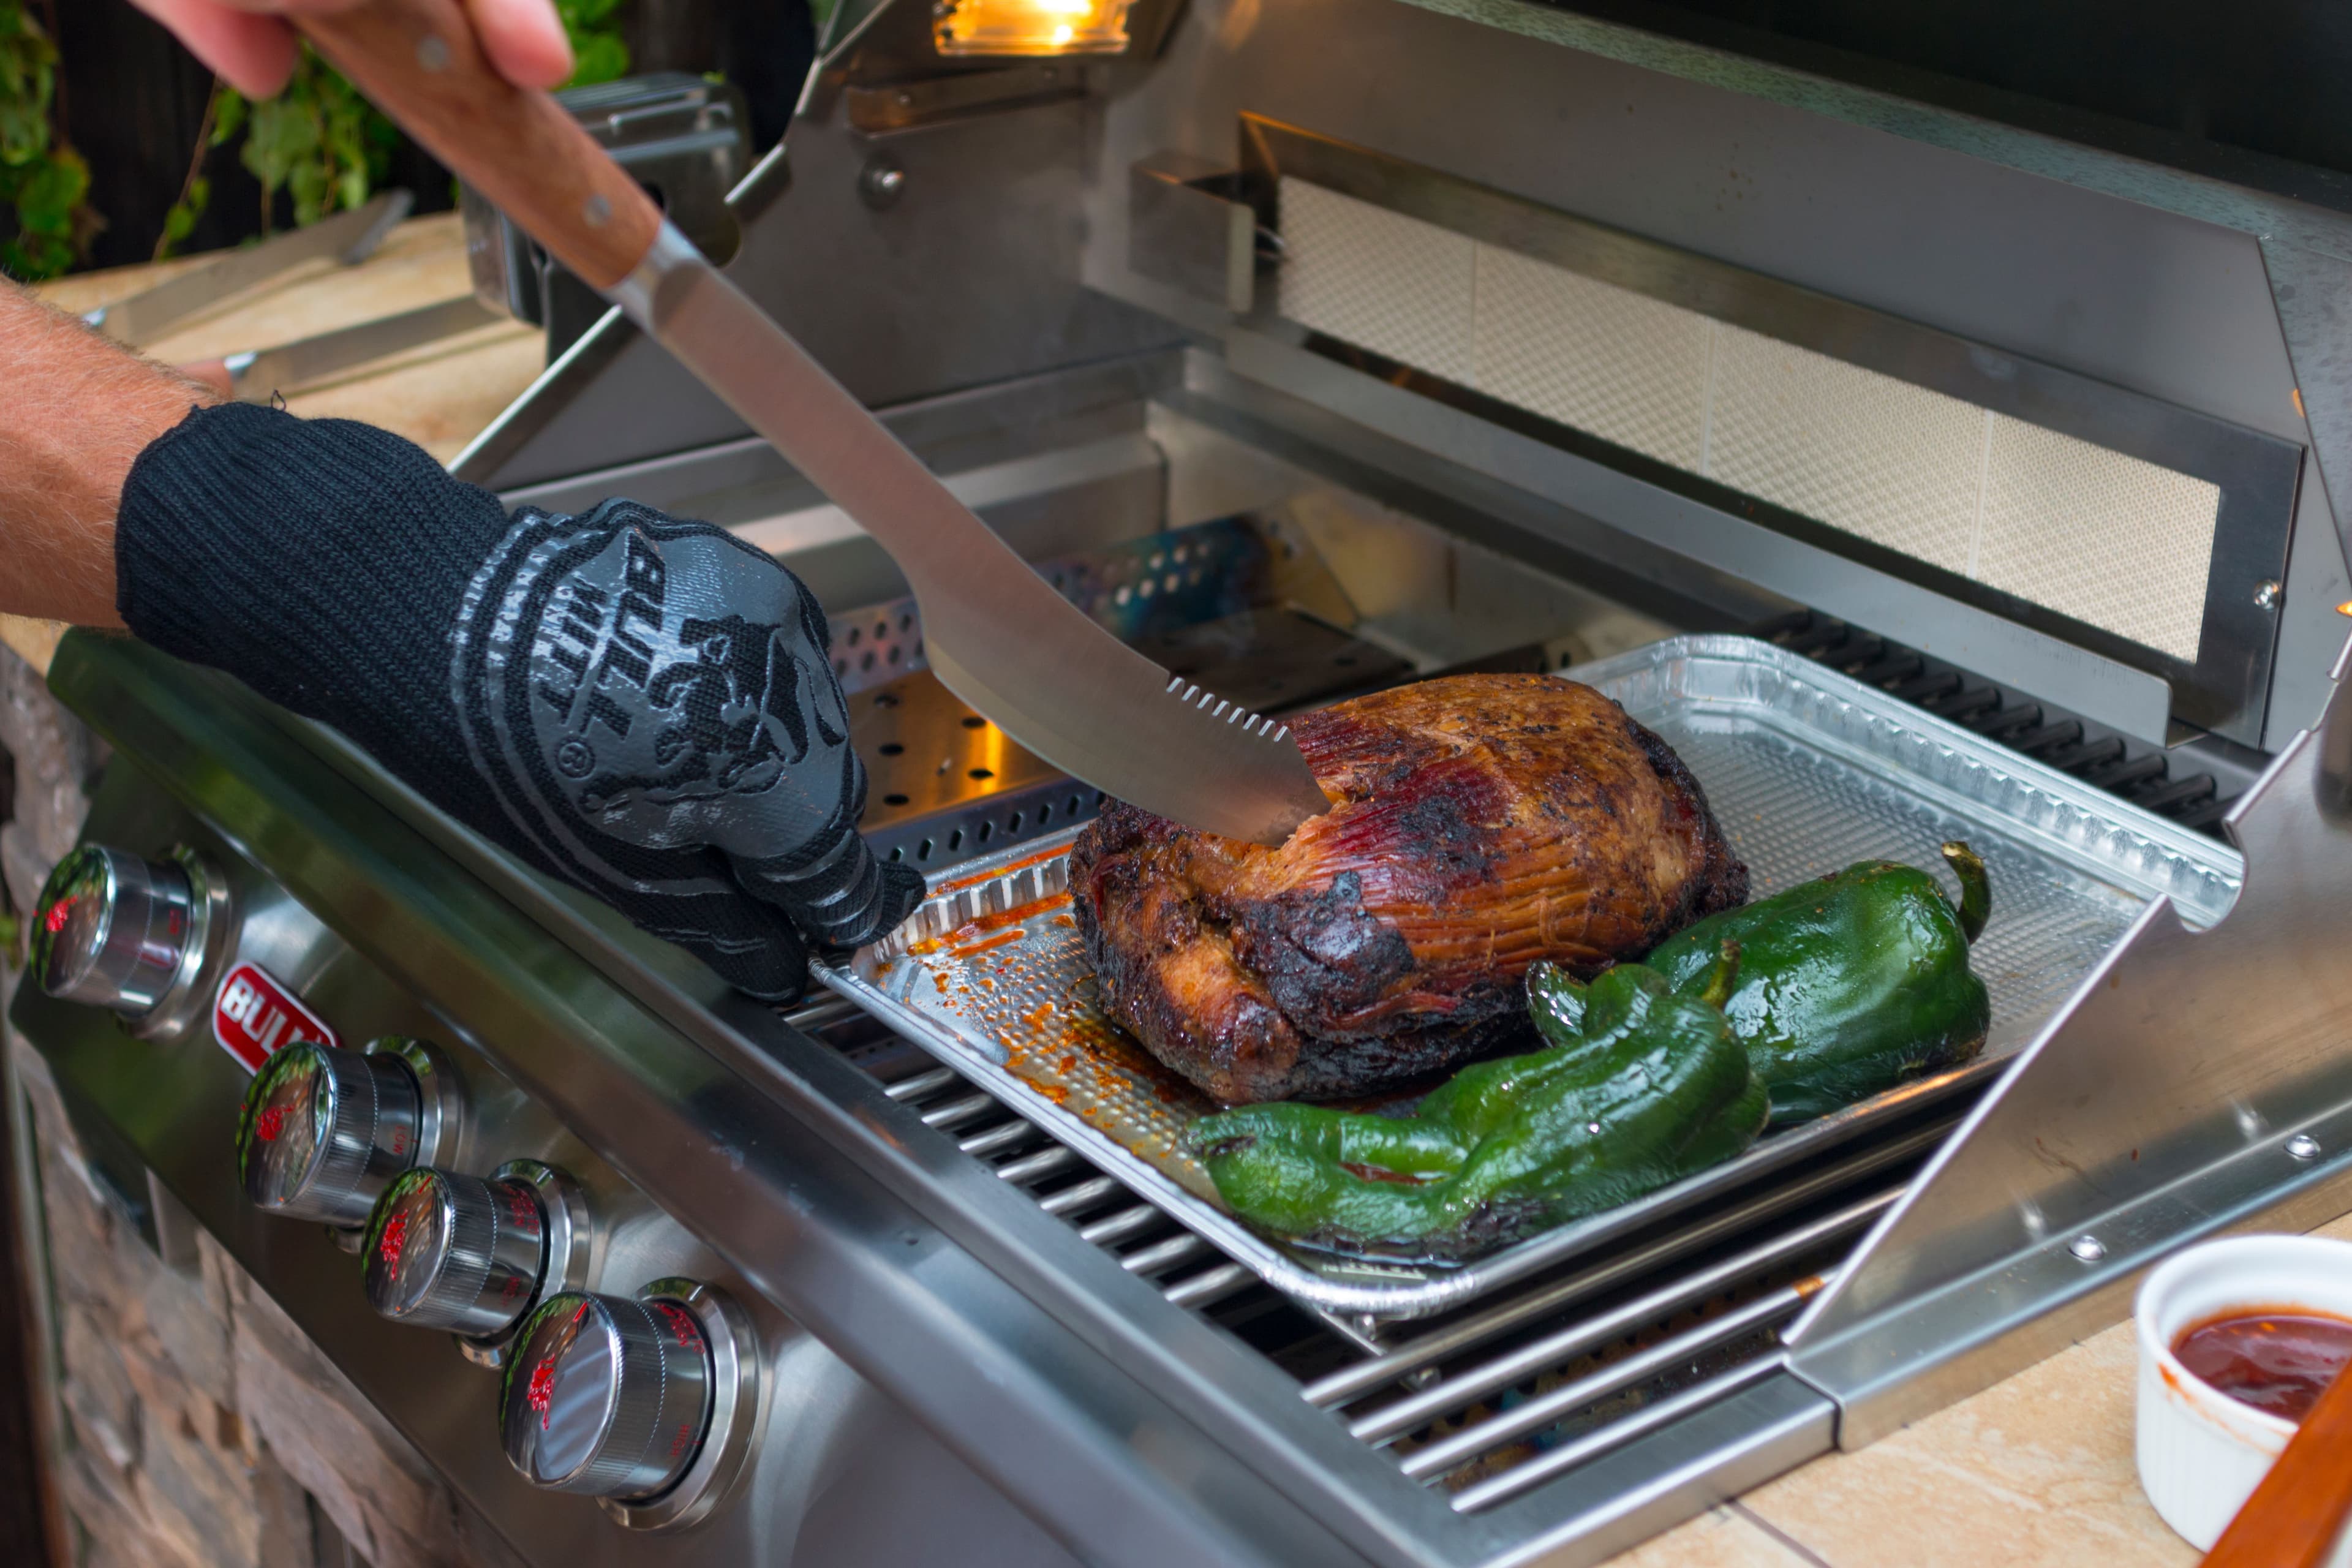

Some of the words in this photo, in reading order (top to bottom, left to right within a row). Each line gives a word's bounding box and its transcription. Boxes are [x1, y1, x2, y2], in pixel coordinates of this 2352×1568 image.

[580, 532, 666, 740] BULL
[393, 1126, 407, 1156] LOW
[671, 1424, 692, 1458] HIGH
